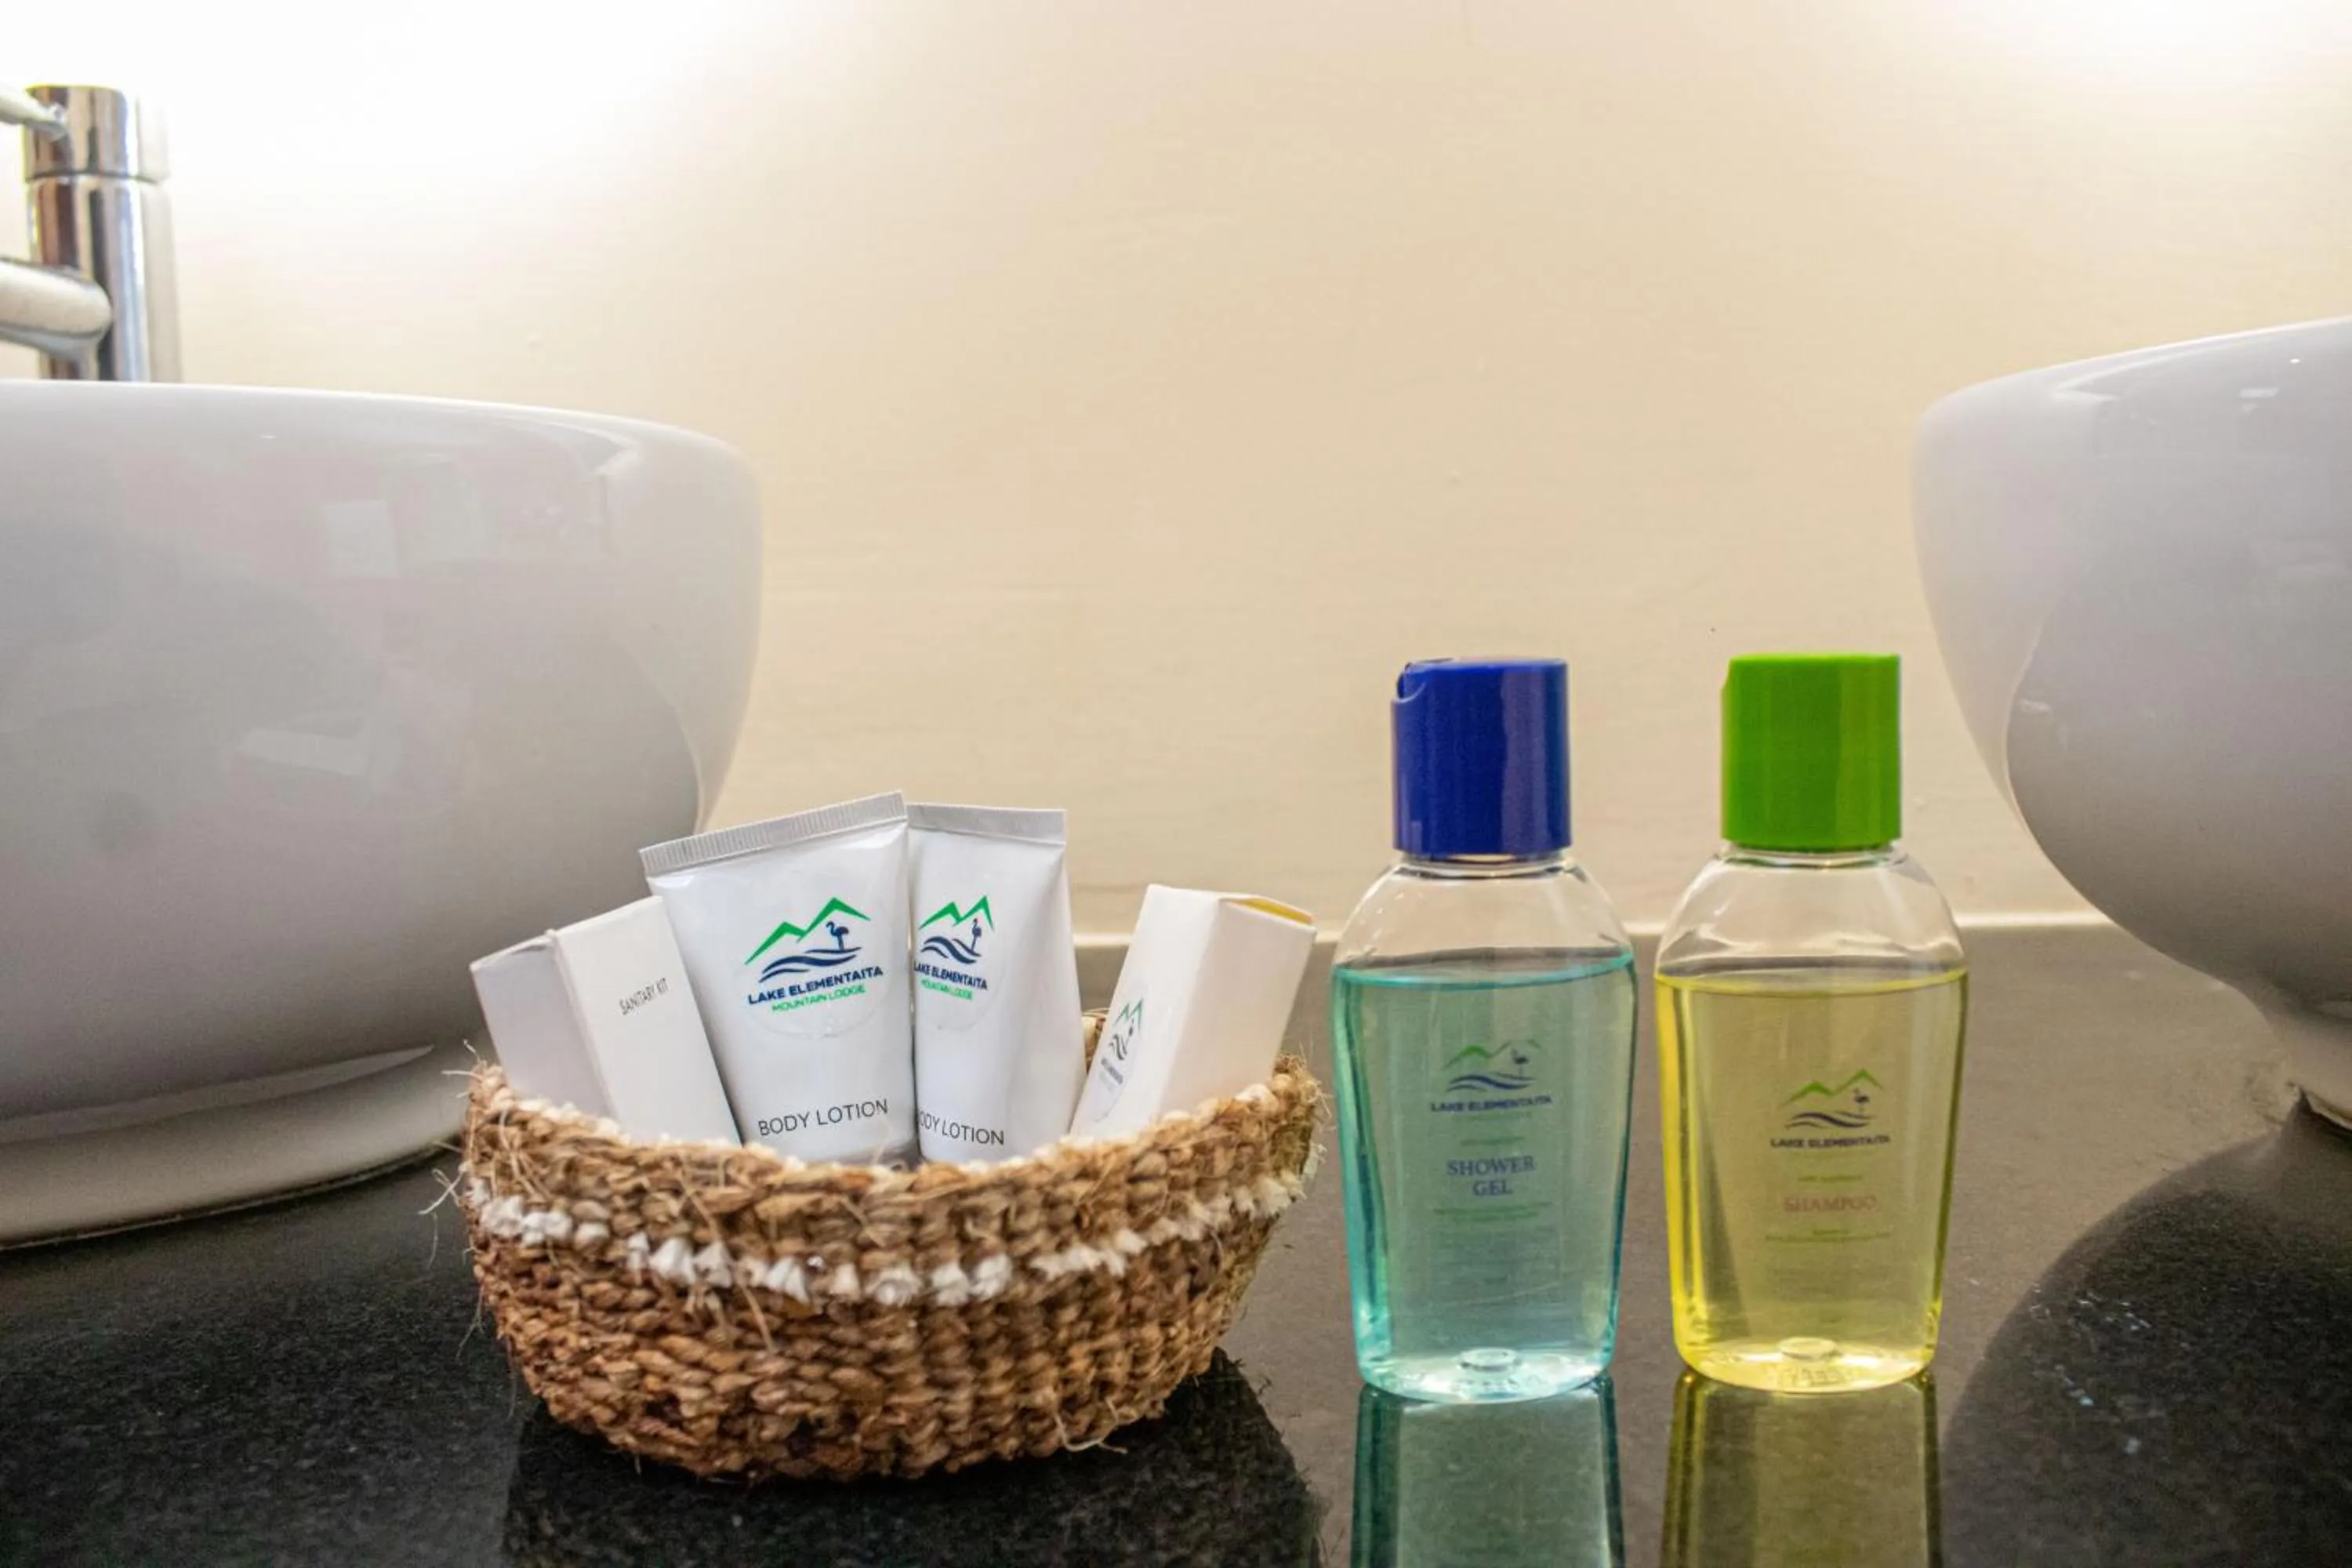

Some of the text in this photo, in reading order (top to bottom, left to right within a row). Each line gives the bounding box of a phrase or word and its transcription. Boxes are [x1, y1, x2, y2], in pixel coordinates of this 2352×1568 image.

[748, 965, 884, 1004] LAKE ELEMENTAITA
[914, 961, 988, 991] LAKE ELEMENTAITA
[771, 985, 866, 1012] MOUNTAIN LODGE
[758, 1098, 888, 1136] BODY LOTION
[918, 1110, 1004, 1145] ODY LOTION
[1446, 1156, 1536, 1176] SHOWER
[1472, 1179, 1513, 1196] GEL
[1783, 1195, 1878, 1212] SHAMPOO
